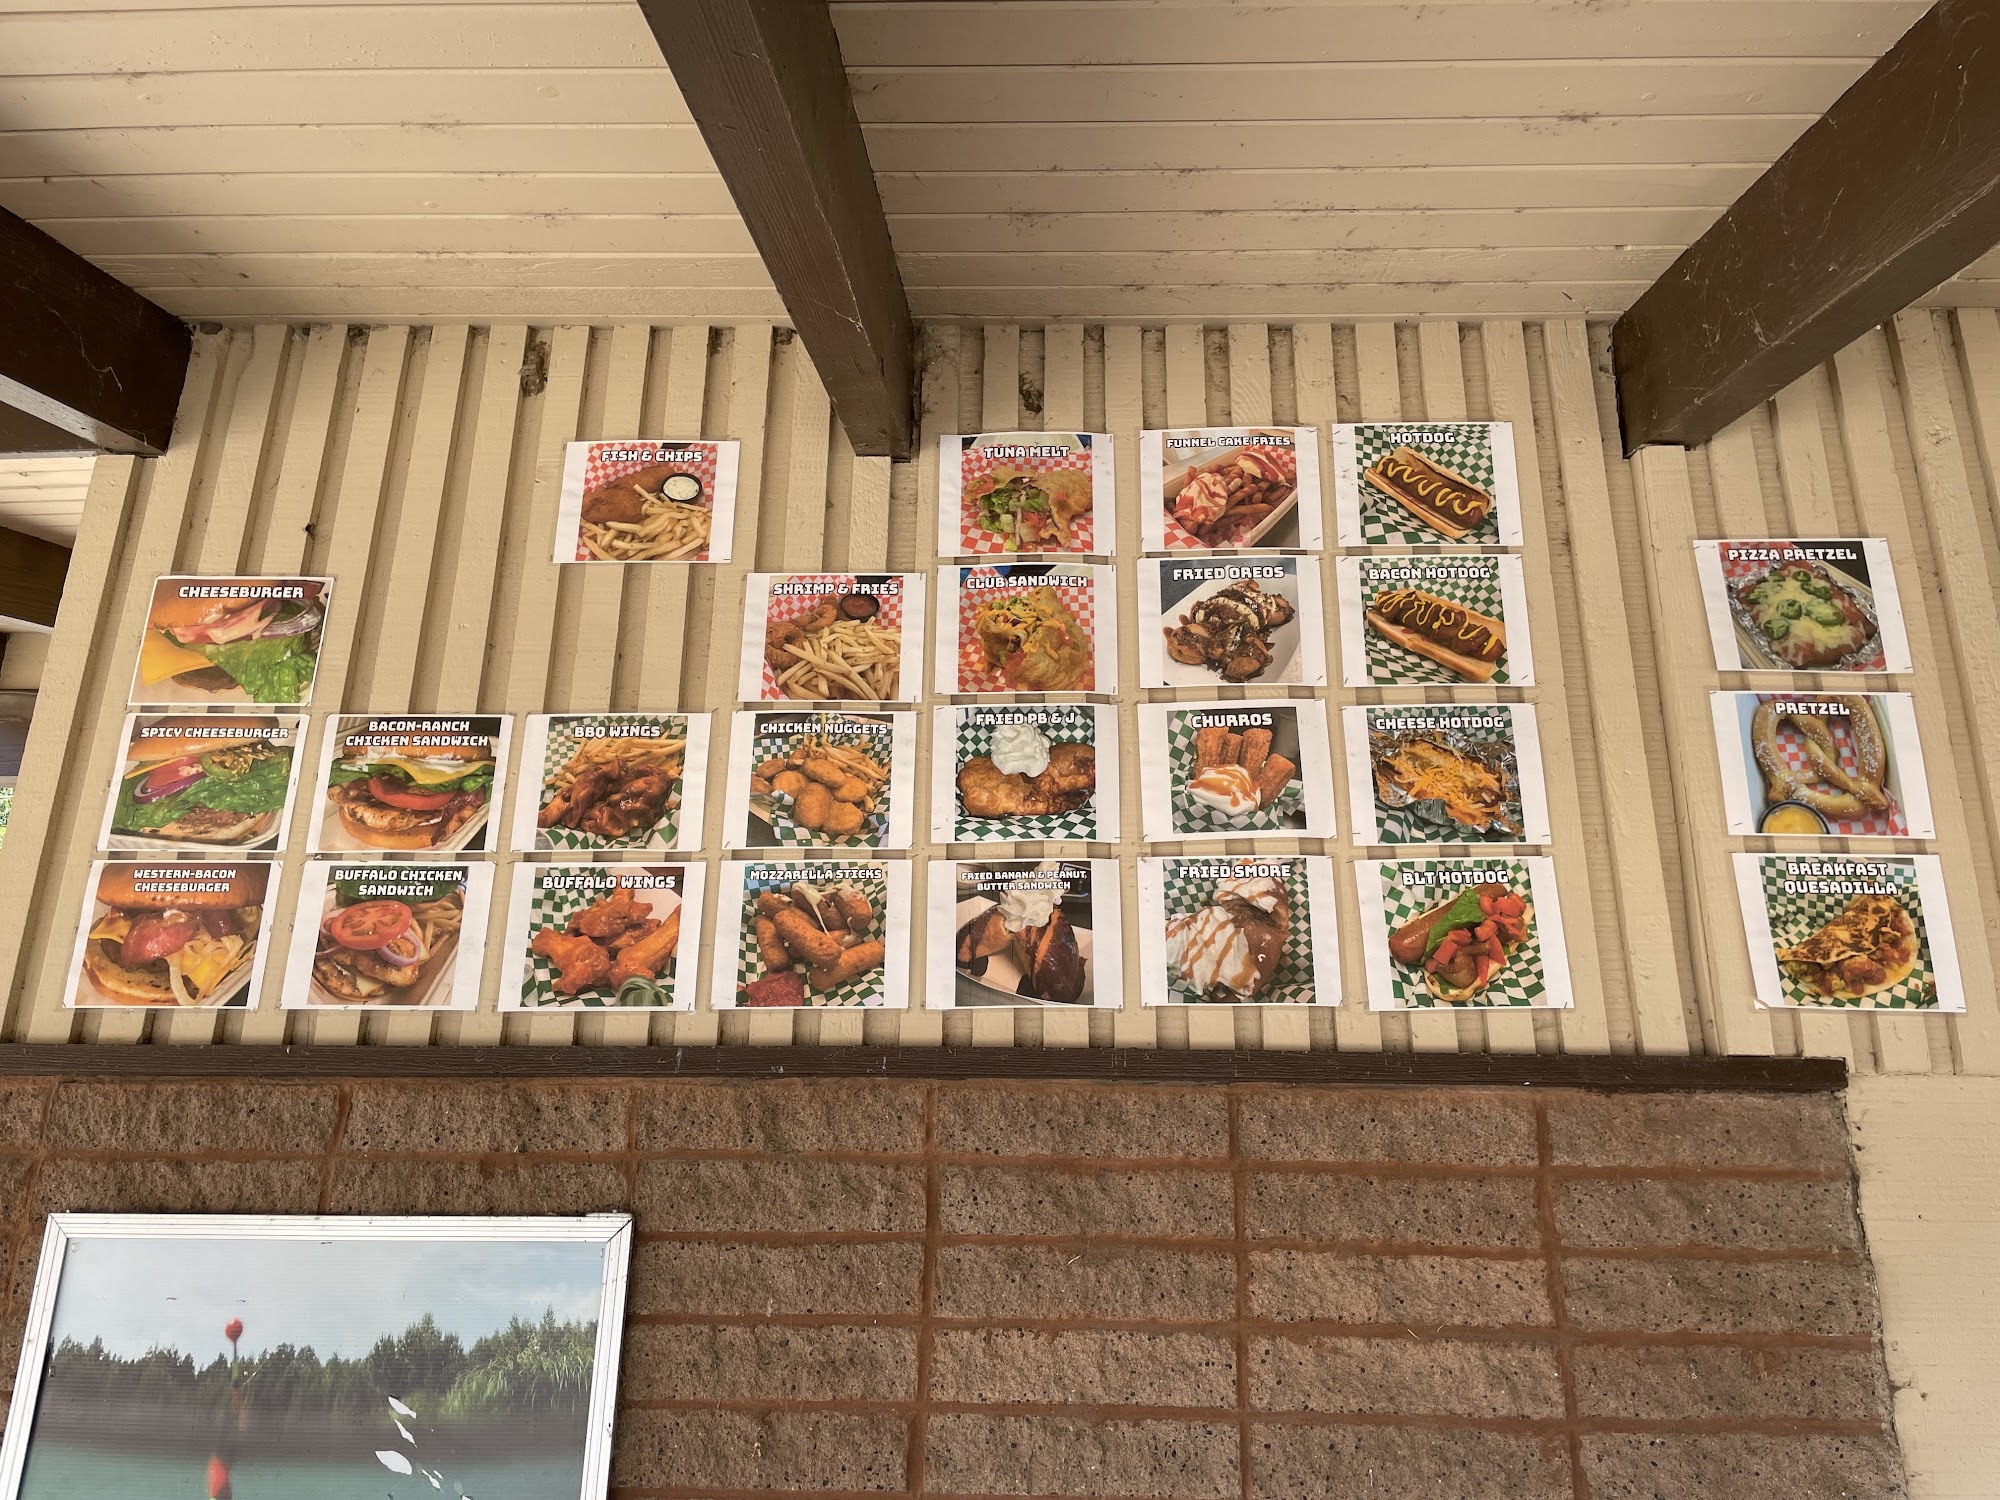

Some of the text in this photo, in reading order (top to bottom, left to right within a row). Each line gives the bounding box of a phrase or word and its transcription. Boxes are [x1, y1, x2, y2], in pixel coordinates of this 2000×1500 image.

[1166, 436, 1290, 448] FUNNEL CAKE FRIES
[1390, 432, 1455, 444] HOTDOG
[601, 450, 703, 462] FISH & CHIPS
[984, 446, 1069, 458] TUNA MELT
[1728, 548, 1857, 560] PIZZA PRETZEL
[1173, 566, 1284, 580] FRIED OREOS
[1368, 567, 1490, 580] BACON HOTDOG
[966, 576, 1088, 589] CLUB SANDWICH
[178, 586, 304, 598] CHEESEBURGER
[773, 584, 898, 595] SHRIMP & FRIES
[1775, 702, 1850, 715] PRETZEL
[976, 713, 1075, 726] FRIED PB & J
[1192, 713, 1273, 728] CHURROS
[1375, 716, 1504, 730] CHEESE HOTDOG
[368, 720, 470, 732] BACON-RANCH
[574, 726, 660, 738] BBQ WINGS
[760, 722, 887, 734] CHICKEN NUGGETS
[141, 728, 288, 738] SPICY CHEESEBURGER
[346, 735, 488, 746] CHICKEN SANDWICH
[134, 869, 236, 880] WESTERN-BACON
[335, 869, 463, 881] BUFFALO CHICKEN
[750, 868, 882, 880] MOZZARELLA STICKS
[961, 870, 1086, 880] FRIED BANANA & PEANUT
[1178, 864, 1290, 879] FRIED SMORE
[1787, 862, 1888, 876] BREAKFAST
[542, 876, 676, 889] BUFFALO WINGS
[1402, 870, 1509, 886] BLT HOTDOG
[134, 881, 230, 892] CHEESEBURGER
[358, 884, 434, 896] SANDWICH
[977, 880, 1070, 891] BUTTER SANDWICH
[1784, 881, 1898, 894] QUESADILLA
